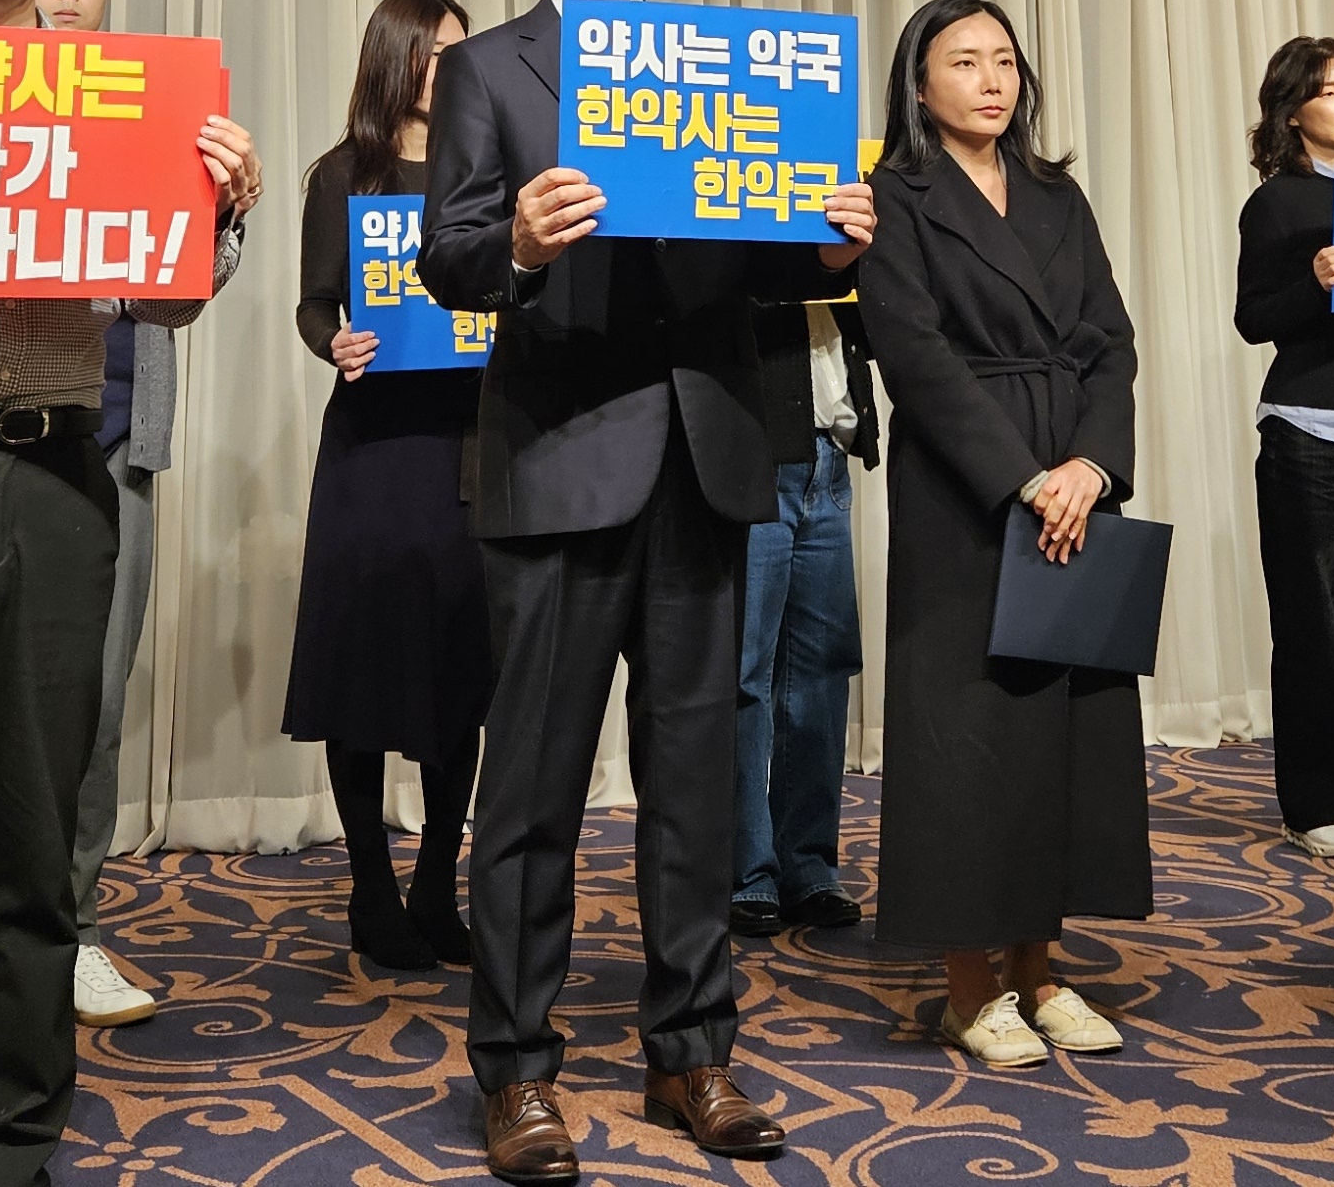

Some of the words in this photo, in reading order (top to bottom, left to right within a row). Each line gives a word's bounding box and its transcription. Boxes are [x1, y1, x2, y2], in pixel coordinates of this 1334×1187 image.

[579, 19, 729, 85] 약사는
[749, 30, 840, 92] 약국
[578, 85, 779, 153] 한약사는
[694, 157, 840, 222] 한약국
